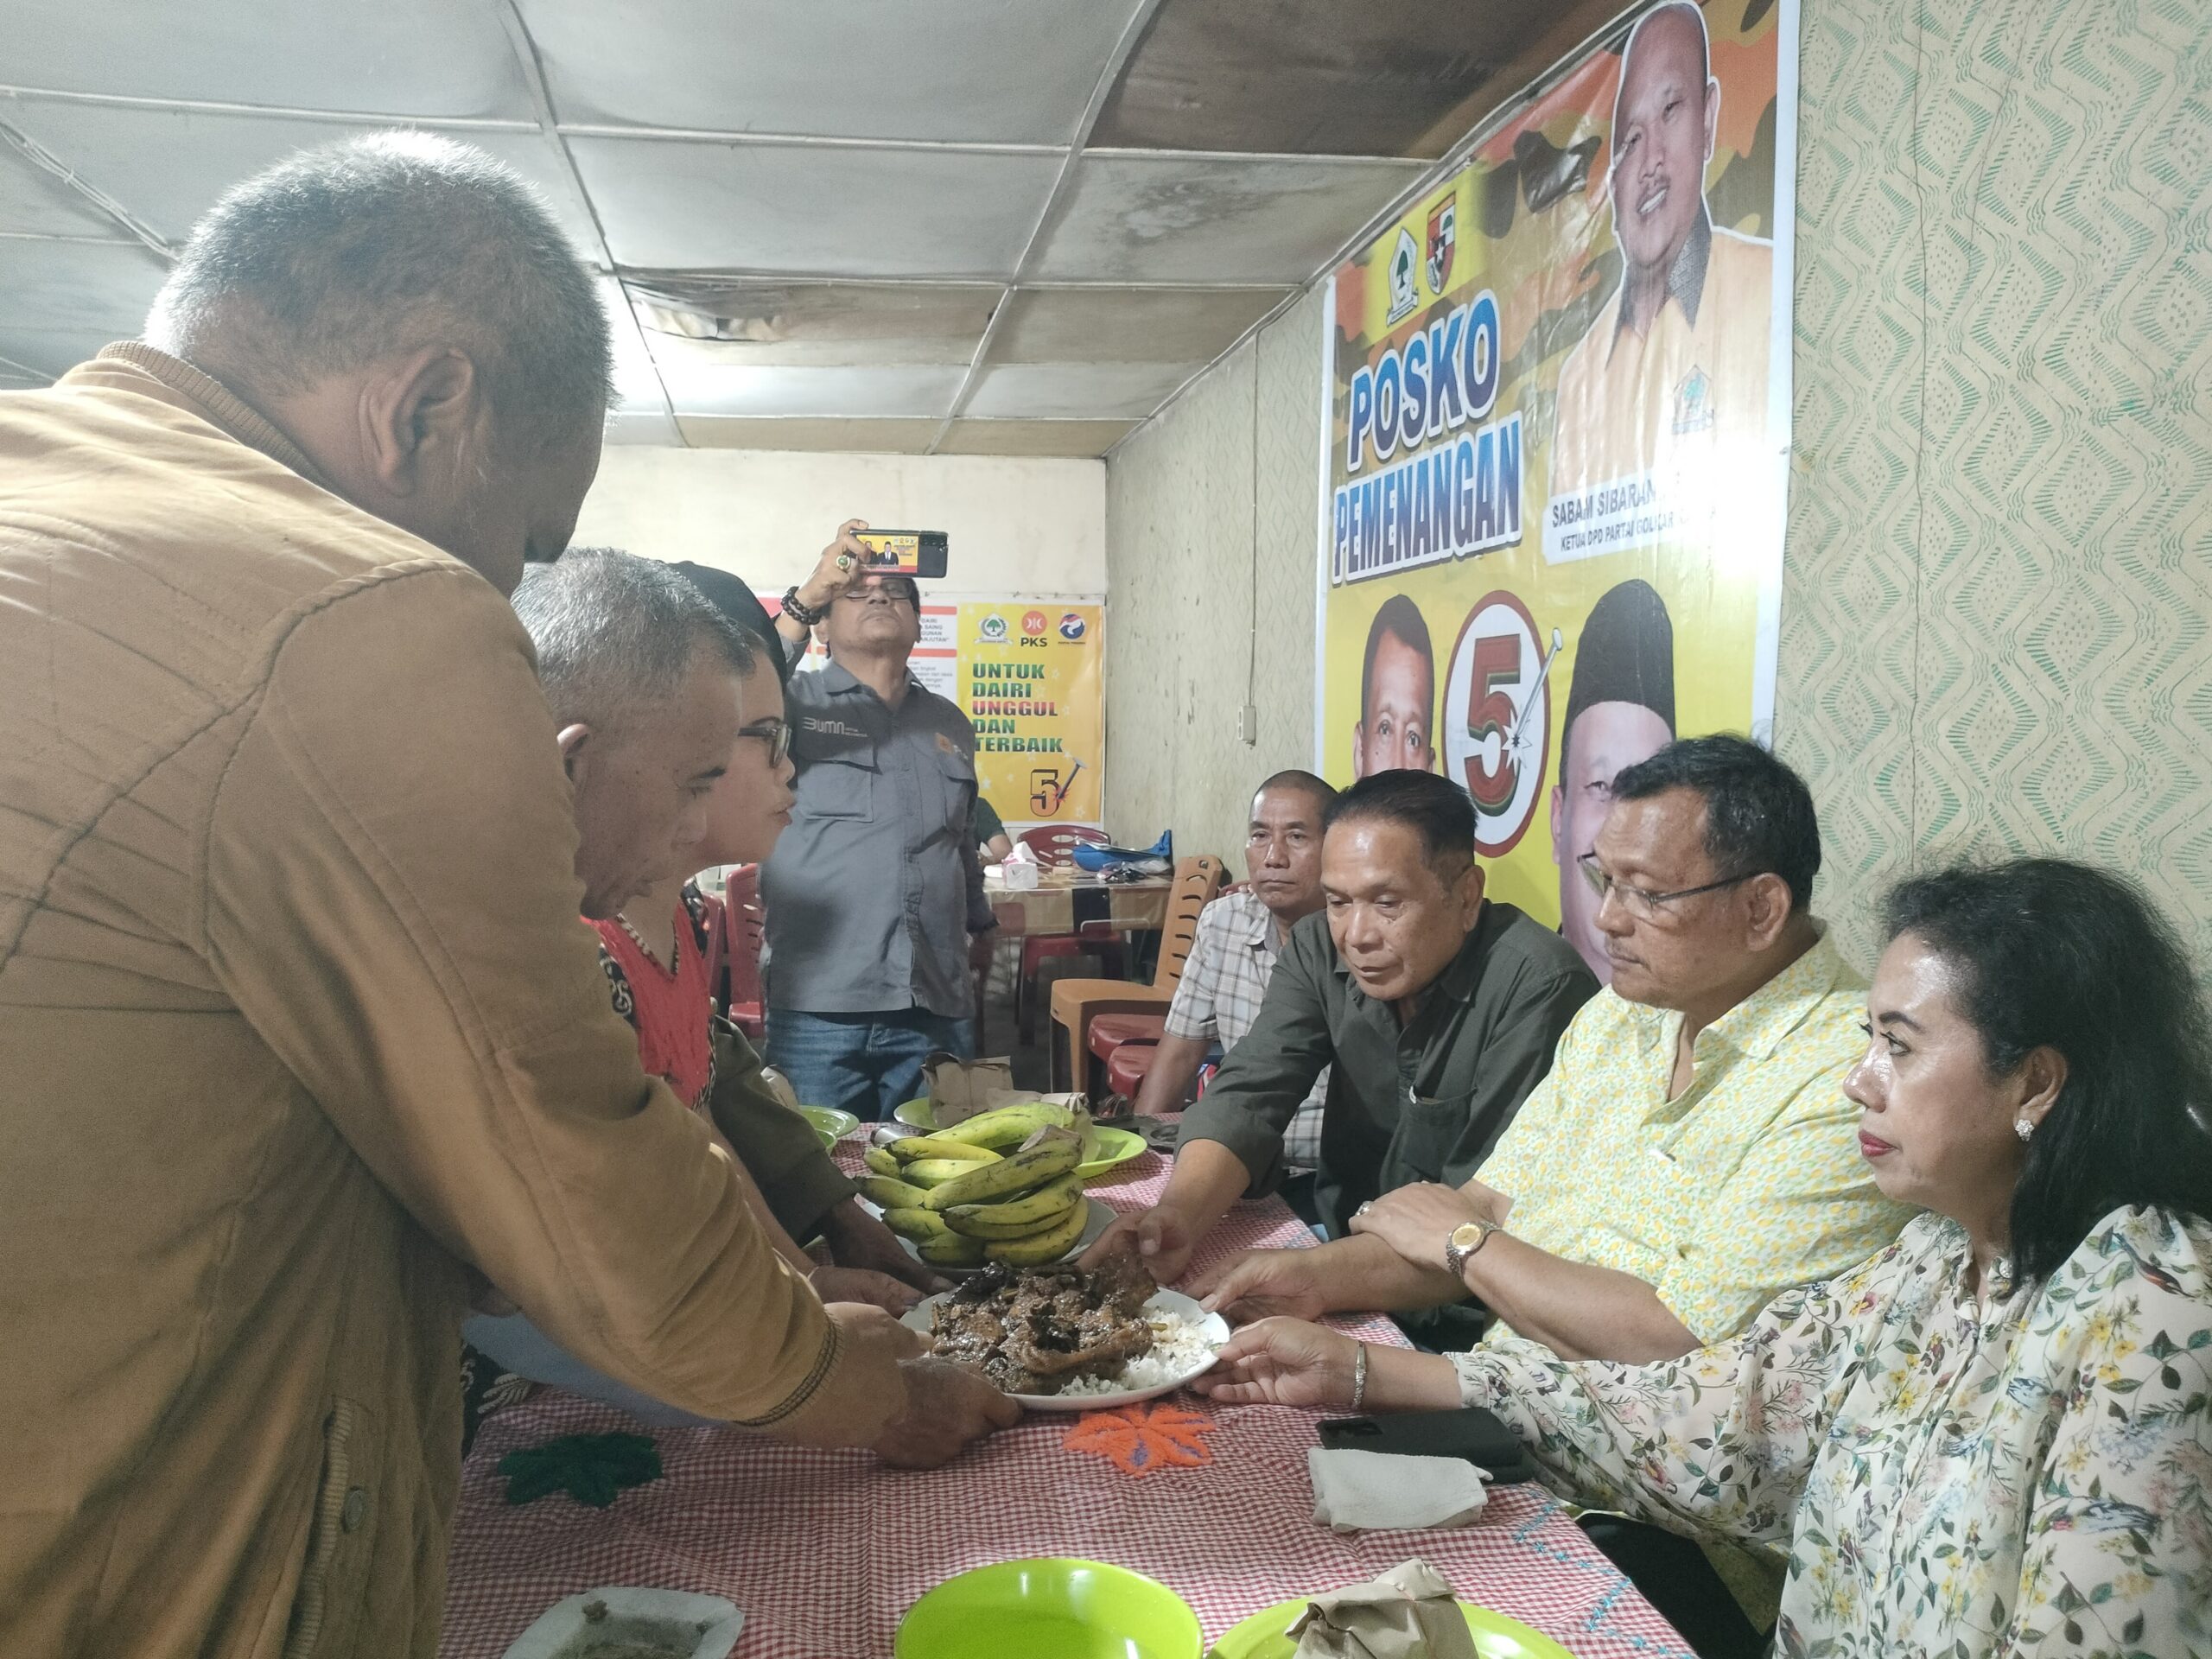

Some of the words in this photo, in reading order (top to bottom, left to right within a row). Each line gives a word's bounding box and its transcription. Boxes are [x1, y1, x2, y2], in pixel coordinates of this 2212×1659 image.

[1348, 295, 1498, 467] POSKO
[1332, 416, 1521, 580] PEMENANGAN
[1552, 493, 1593, 528] SABAM
[1597, 478, 1657, 517] SIBARAN
[1560, 534, 1586, 552] KETUA
[1587, 530, 1604, 547] DPD
[1605, 522, 1635, 543] PARTAI
[1020, 637, 1048, 648] PKS
[973, 664, 1046, 679] UNTUK
[973, 683, 1032, 698] DAIRI
[973, 701, 1058, 716] UNGGUL
[973, 719, 1015, 734] DAN
[1464, 632, 1522, 817] 5
[975, 737, 1063, 753] TERBAIK
[1030, 769, 1061, 817] 5
